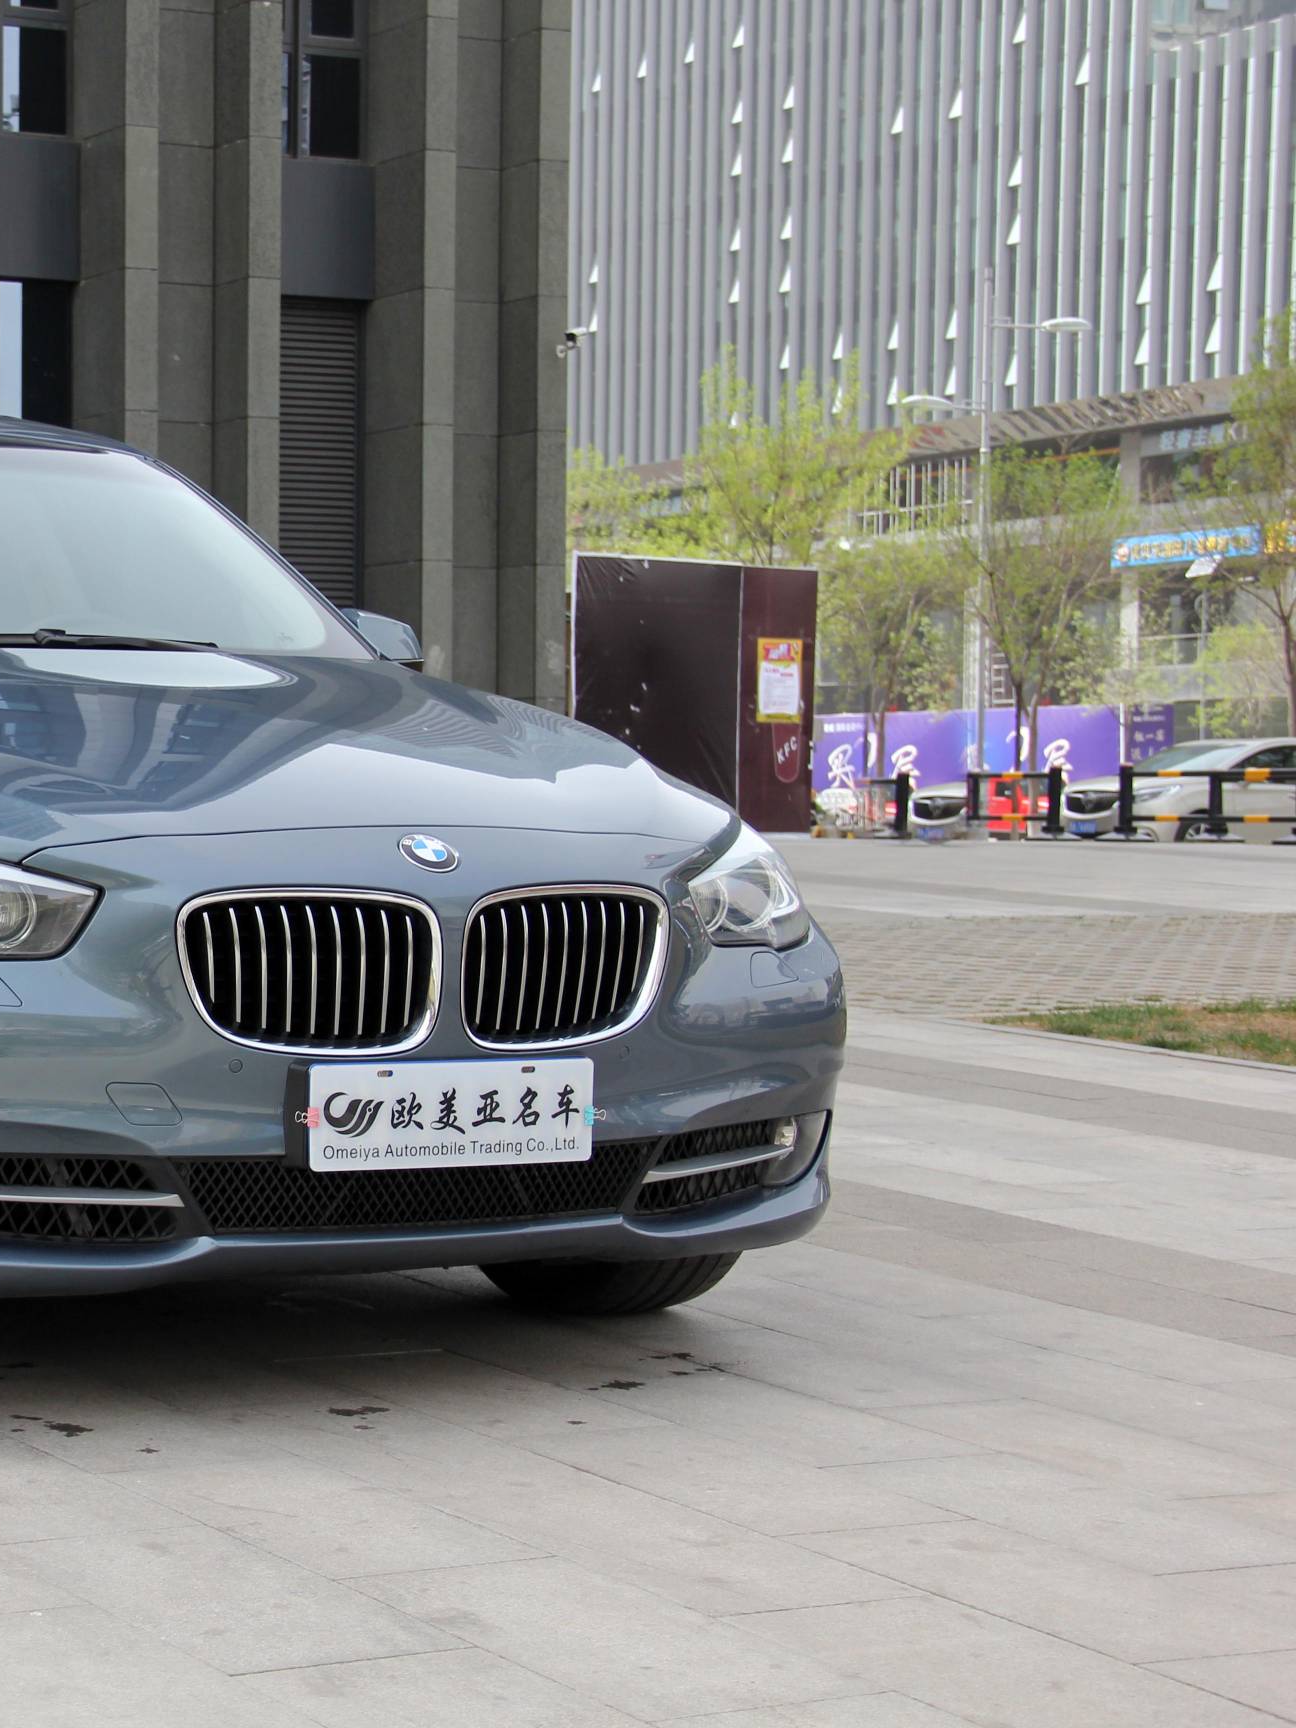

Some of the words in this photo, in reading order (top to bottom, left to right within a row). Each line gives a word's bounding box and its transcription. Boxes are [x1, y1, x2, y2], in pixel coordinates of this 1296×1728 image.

[776, 736, 798, 765] KFC
[390, 1084, 580, 1135] 欧美亚名车
[322, 1144, 380, 1162] Omeiya
[384, 1140, 466, 1159] Automobile
[470, 1138, 523, 1157] Trading
[526, 1136, 580, 1153] Co.,Ltd.
